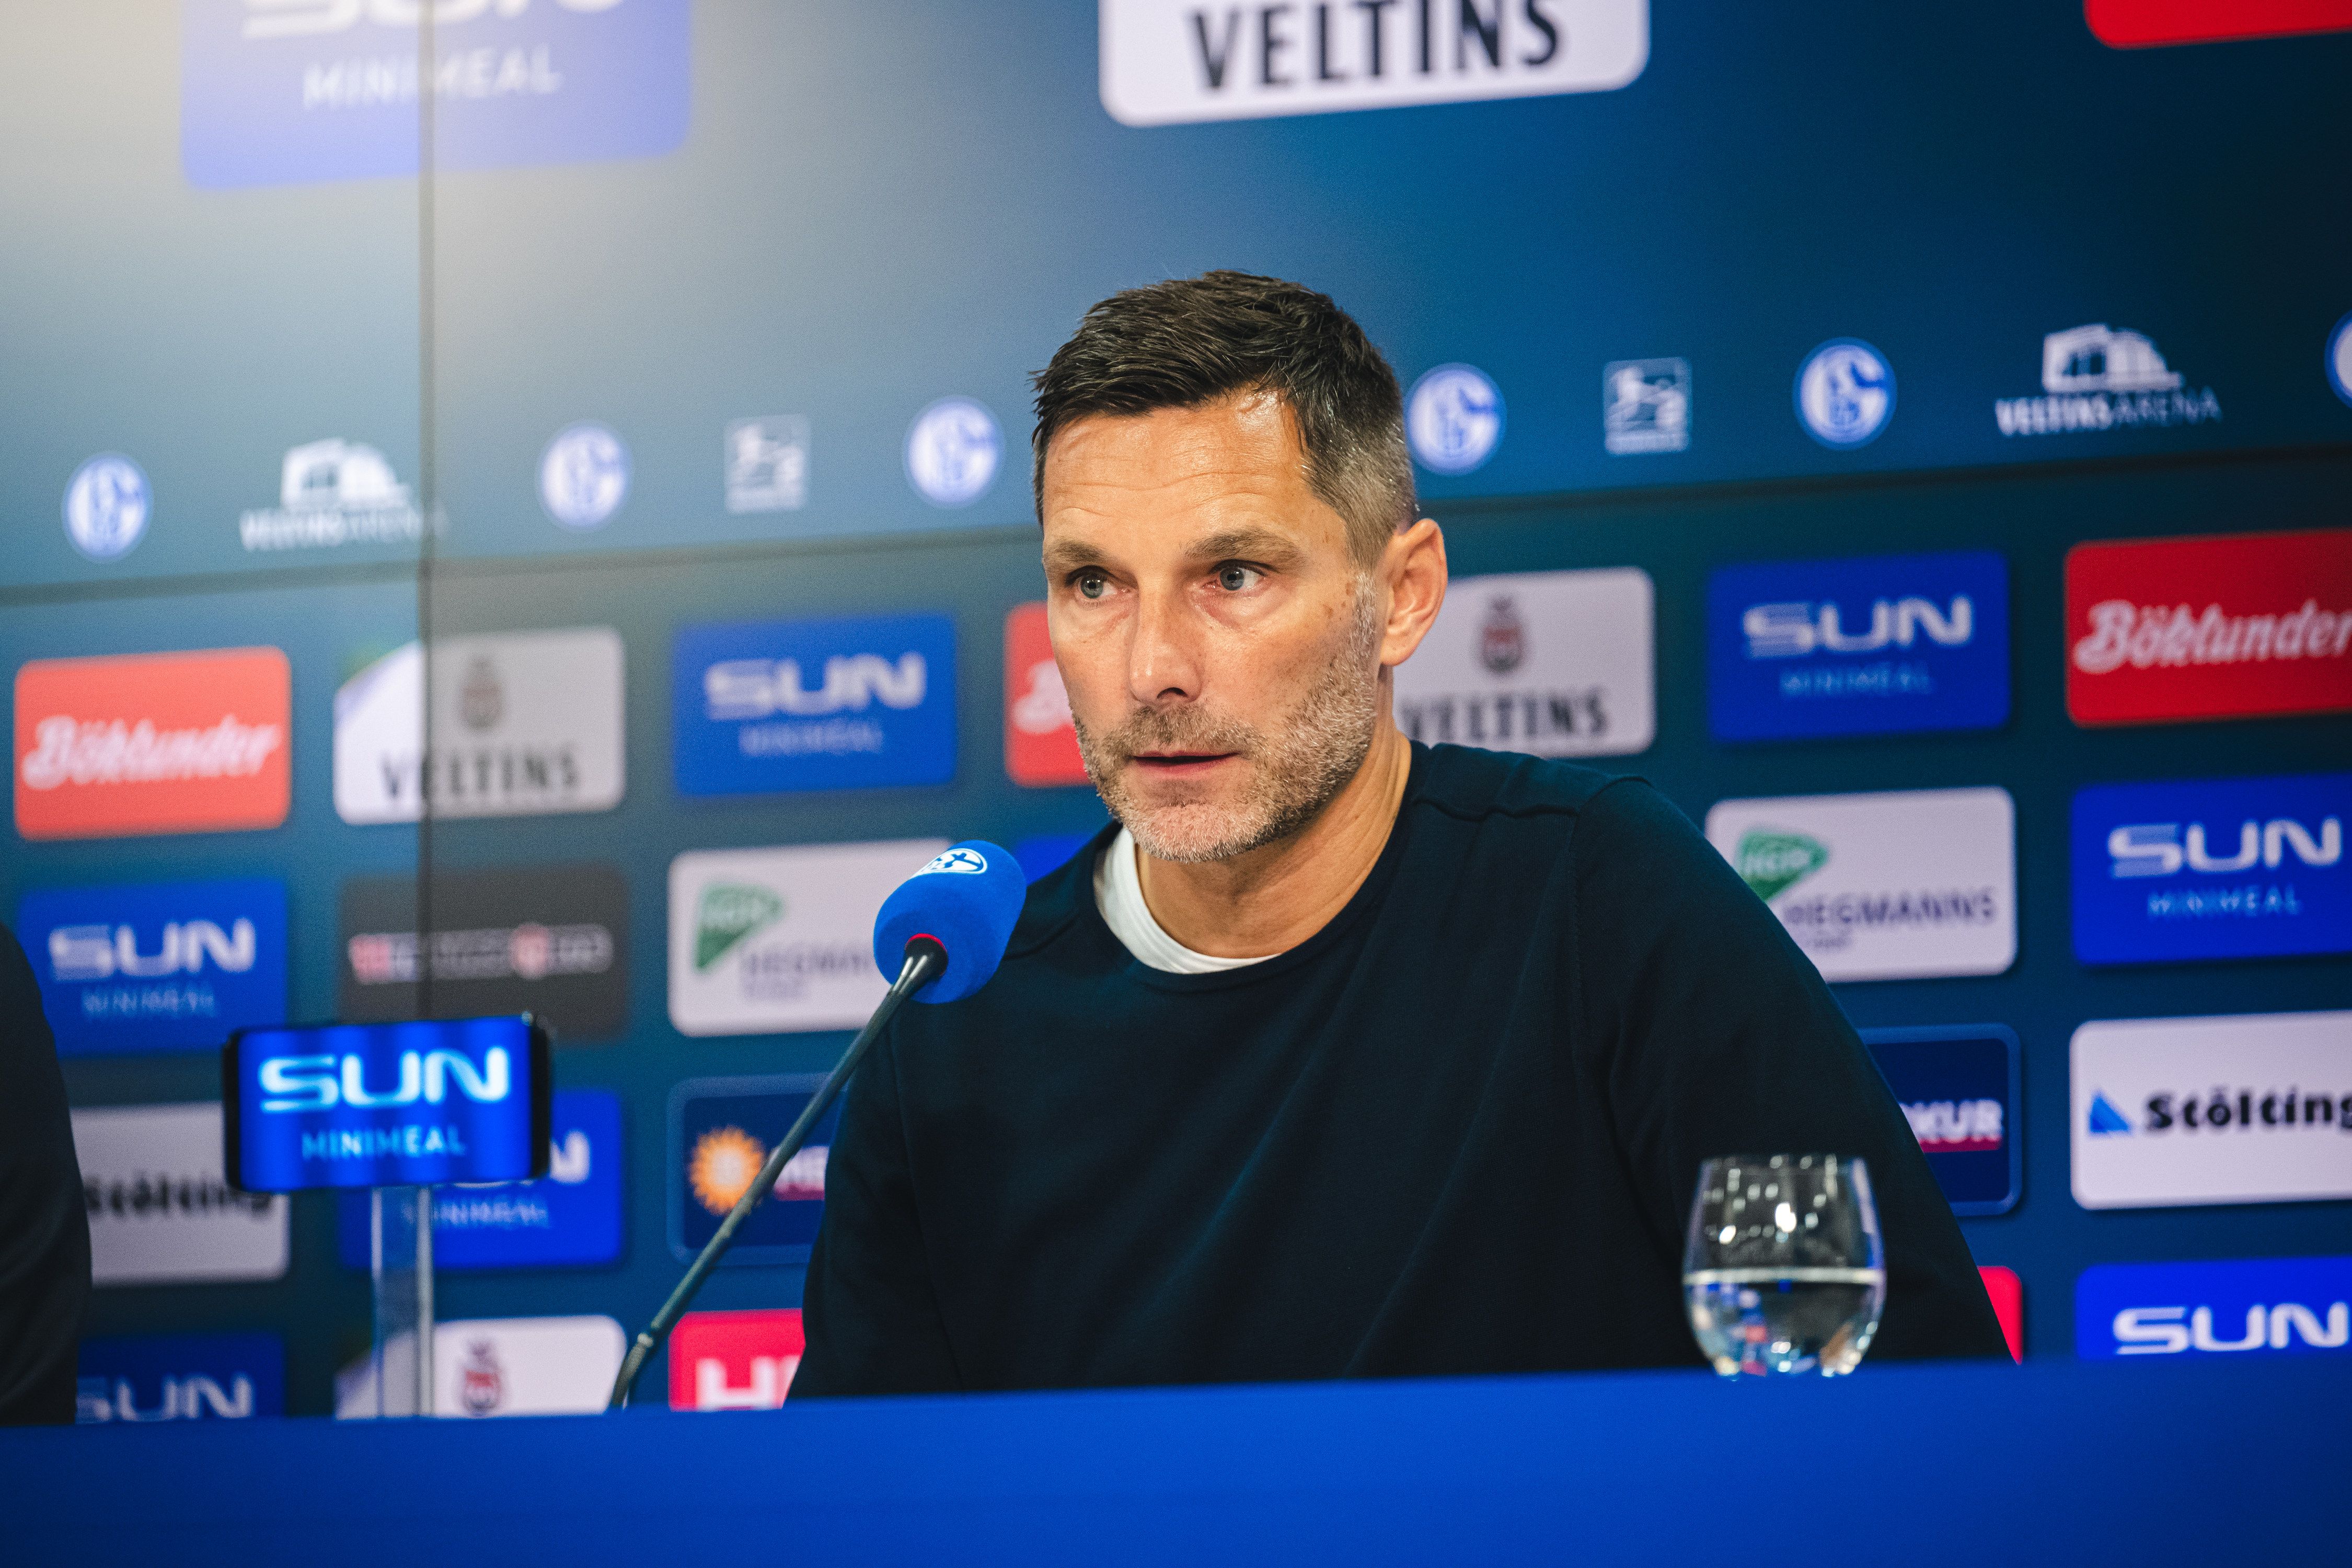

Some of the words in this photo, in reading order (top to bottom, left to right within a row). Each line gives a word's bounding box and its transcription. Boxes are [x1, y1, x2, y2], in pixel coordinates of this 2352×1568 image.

[303, 44, 562, 109] MINIMEAL
[1190, 0, 1563, 90] VELTINS
[1743, 594, 1971, 660] SUN
[704, 652, 926, 720] SUN
[1397, 686, 1609, 744] VELTINS
[2108, 815, 2341, 879] SUN
[2147, 884, 2301, 923] MINIMEAL
[49, 918, 255, 982] SUN
[258, 1047, 510, 1113] SUN
[301, 1126, 465, 1160] MINIMEAL
[2113, 1301, 2348, 1355] SUN
